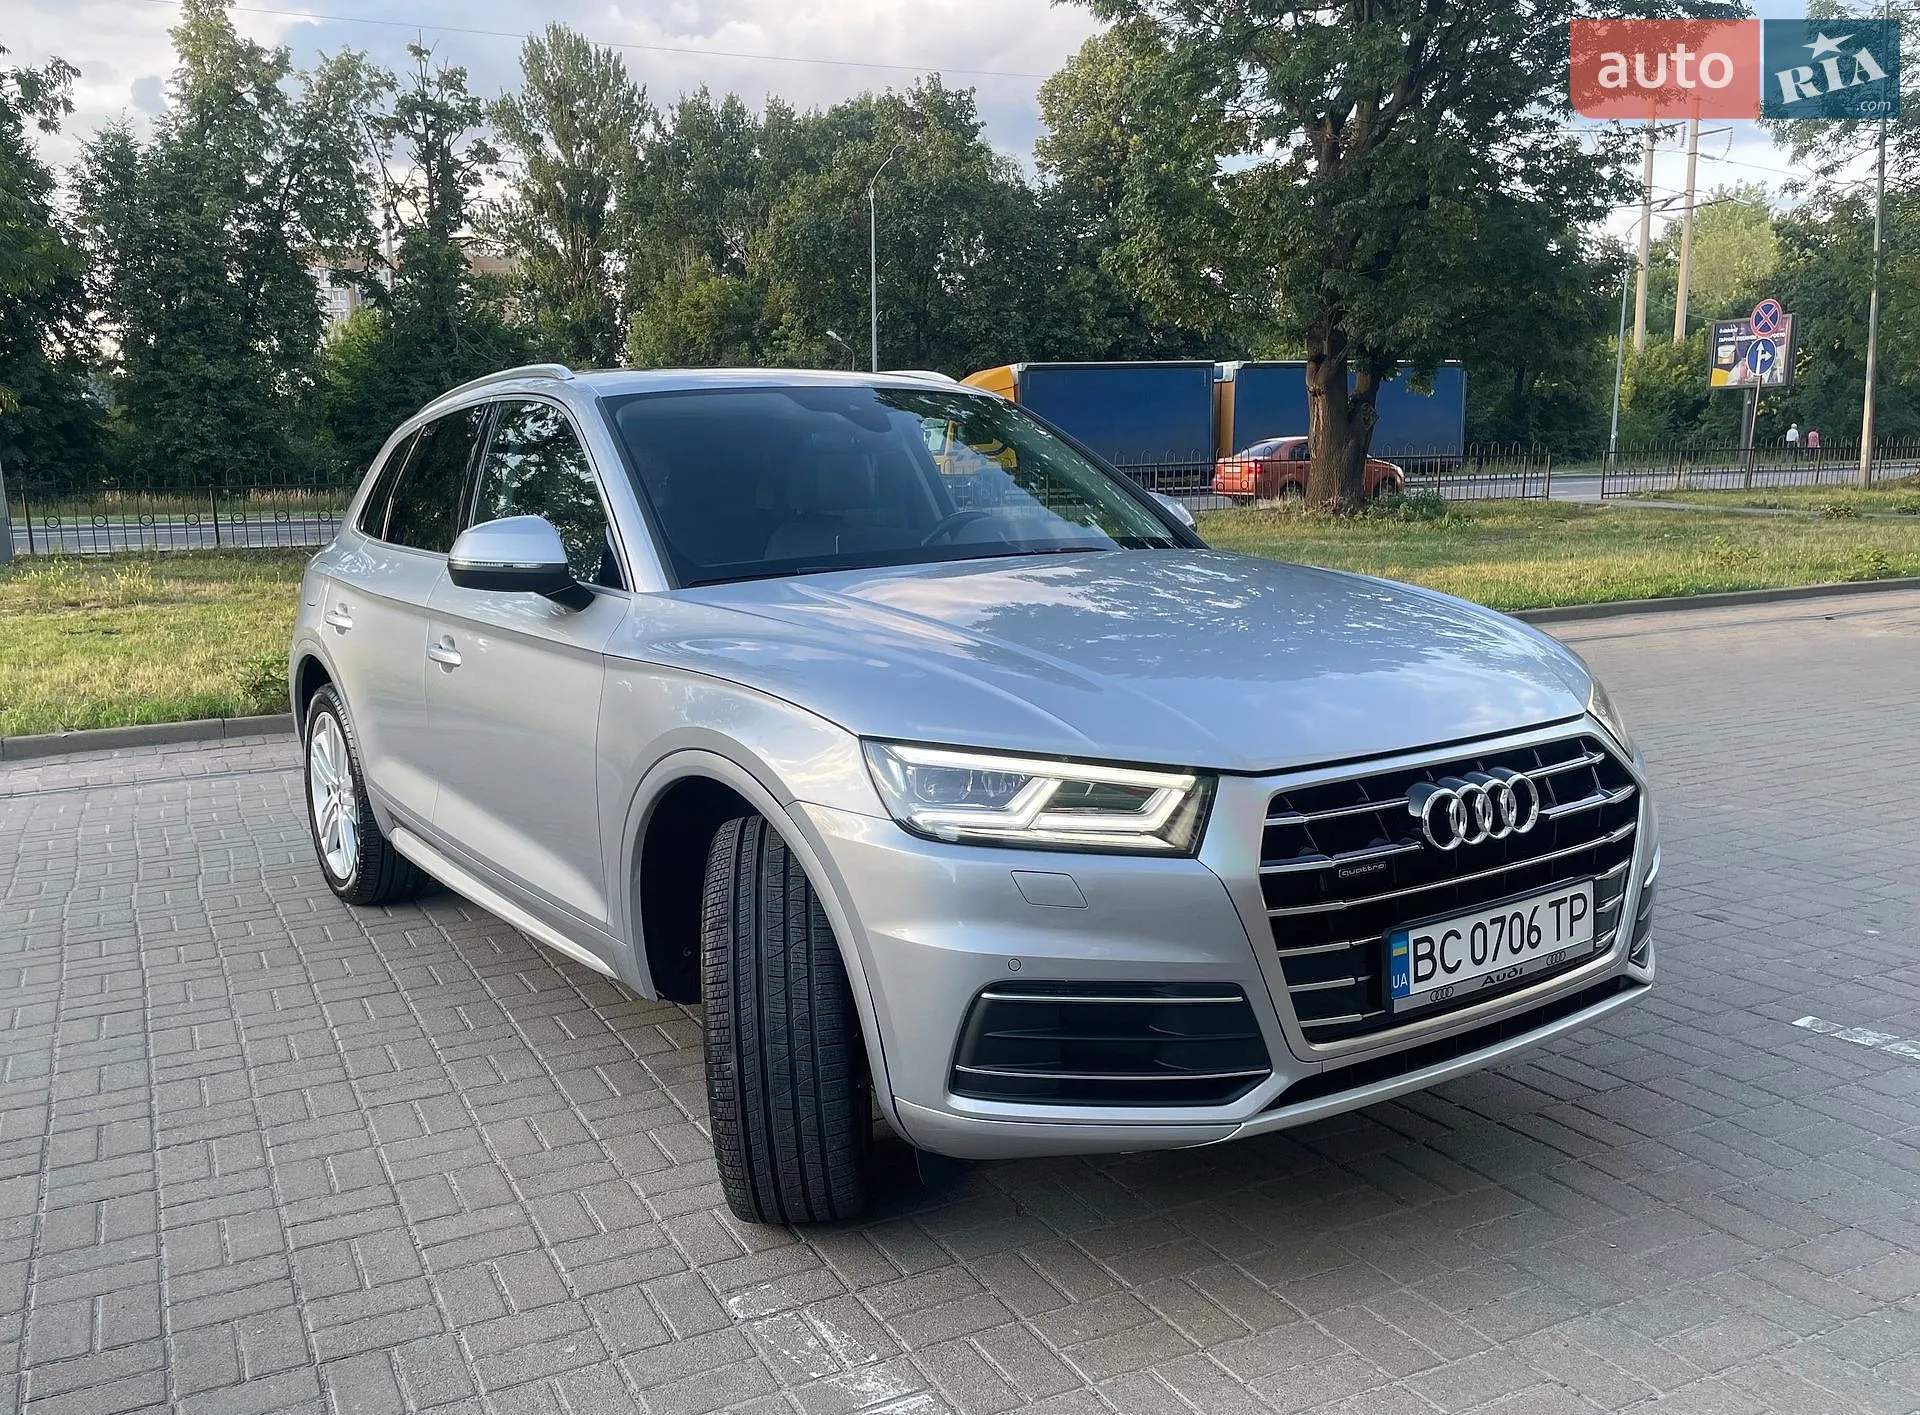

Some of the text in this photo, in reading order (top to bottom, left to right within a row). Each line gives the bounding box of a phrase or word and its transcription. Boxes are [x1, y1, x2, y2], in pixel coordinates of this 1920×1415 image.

[1341, 863, 1385, 877] quattro
[1412, 892, 1588, 985] BC 0706 TP
[1392, 972, 1408, 989] UA
[1480, 967, 1524, 988] Audi
